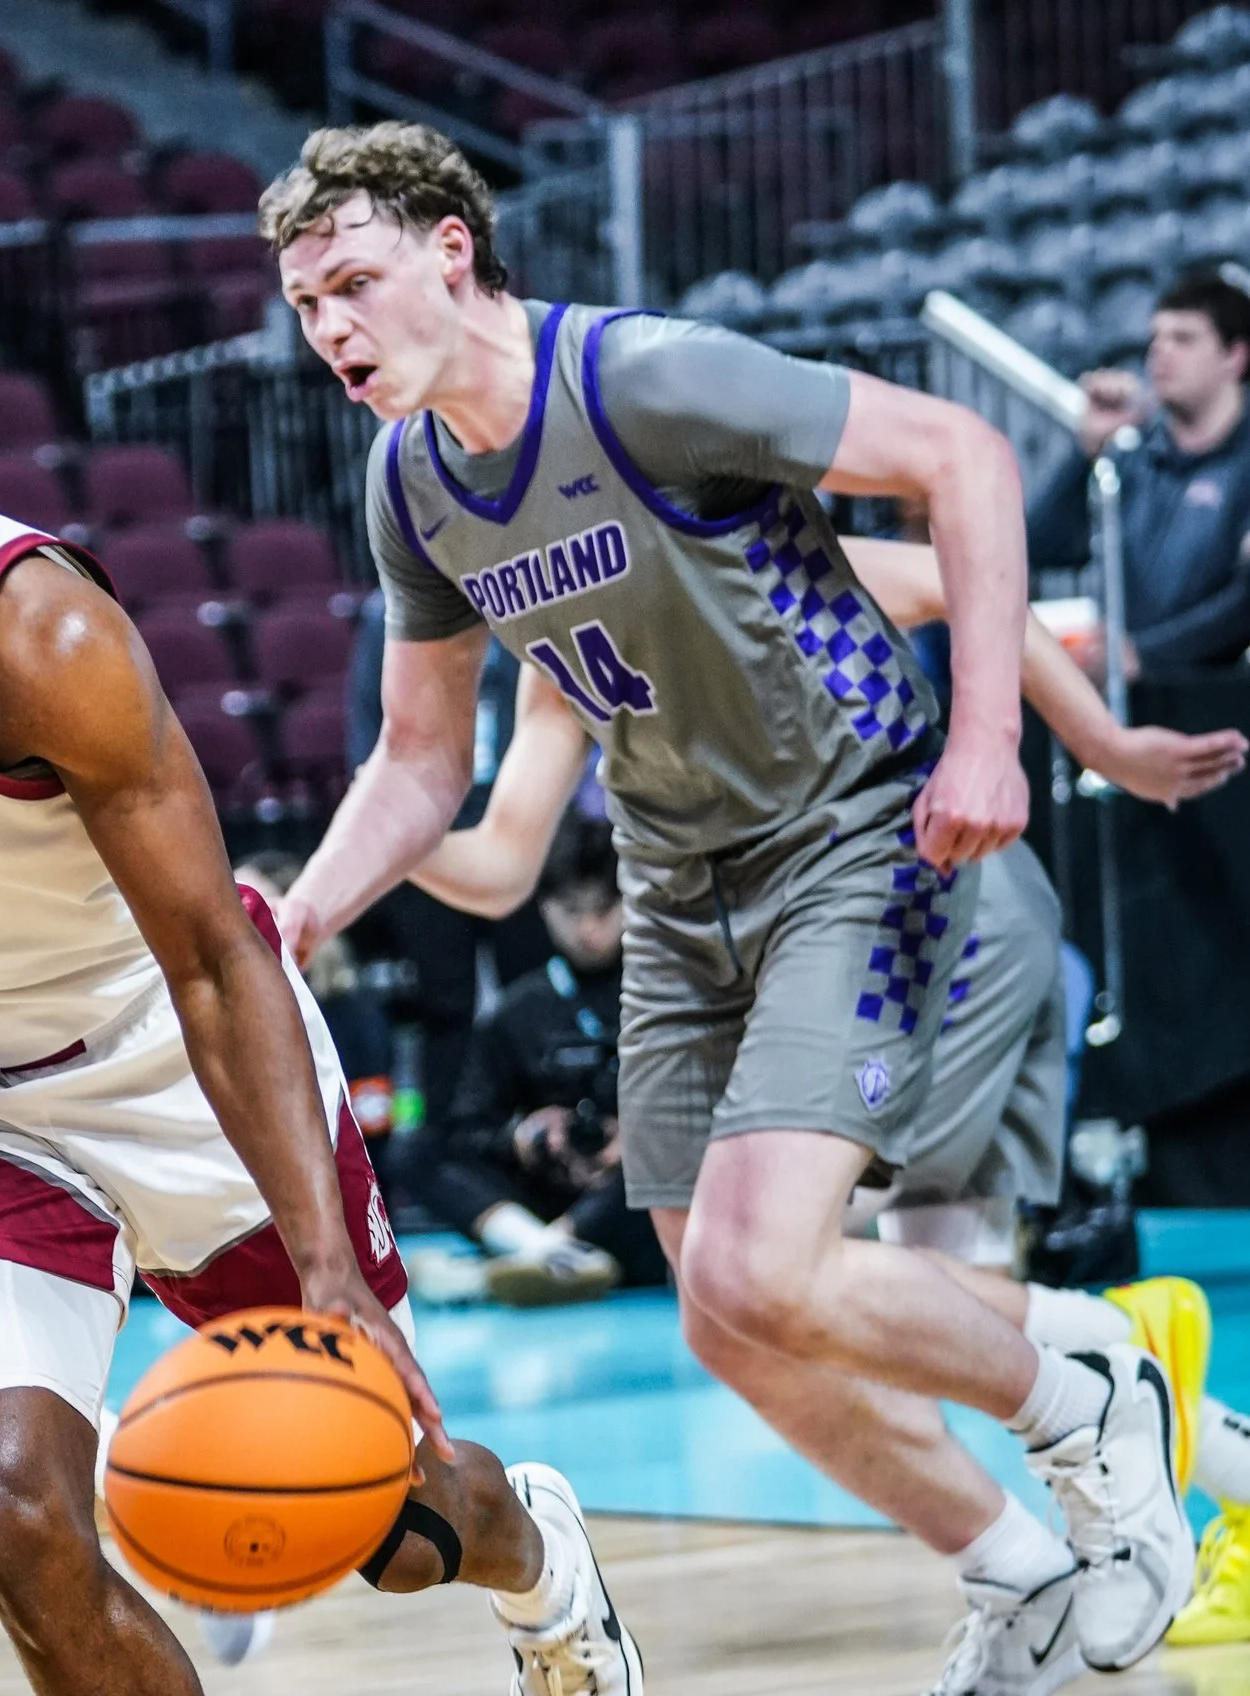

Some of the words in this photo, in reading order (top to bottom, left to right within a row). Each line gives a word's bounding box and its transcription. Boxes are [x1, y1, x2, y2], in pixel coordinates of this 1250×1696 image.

[460, 520, 630, 623] PORTLAND
[526, 618, 657, 727] 14
[211, 1322, 355, 1370] WCC
